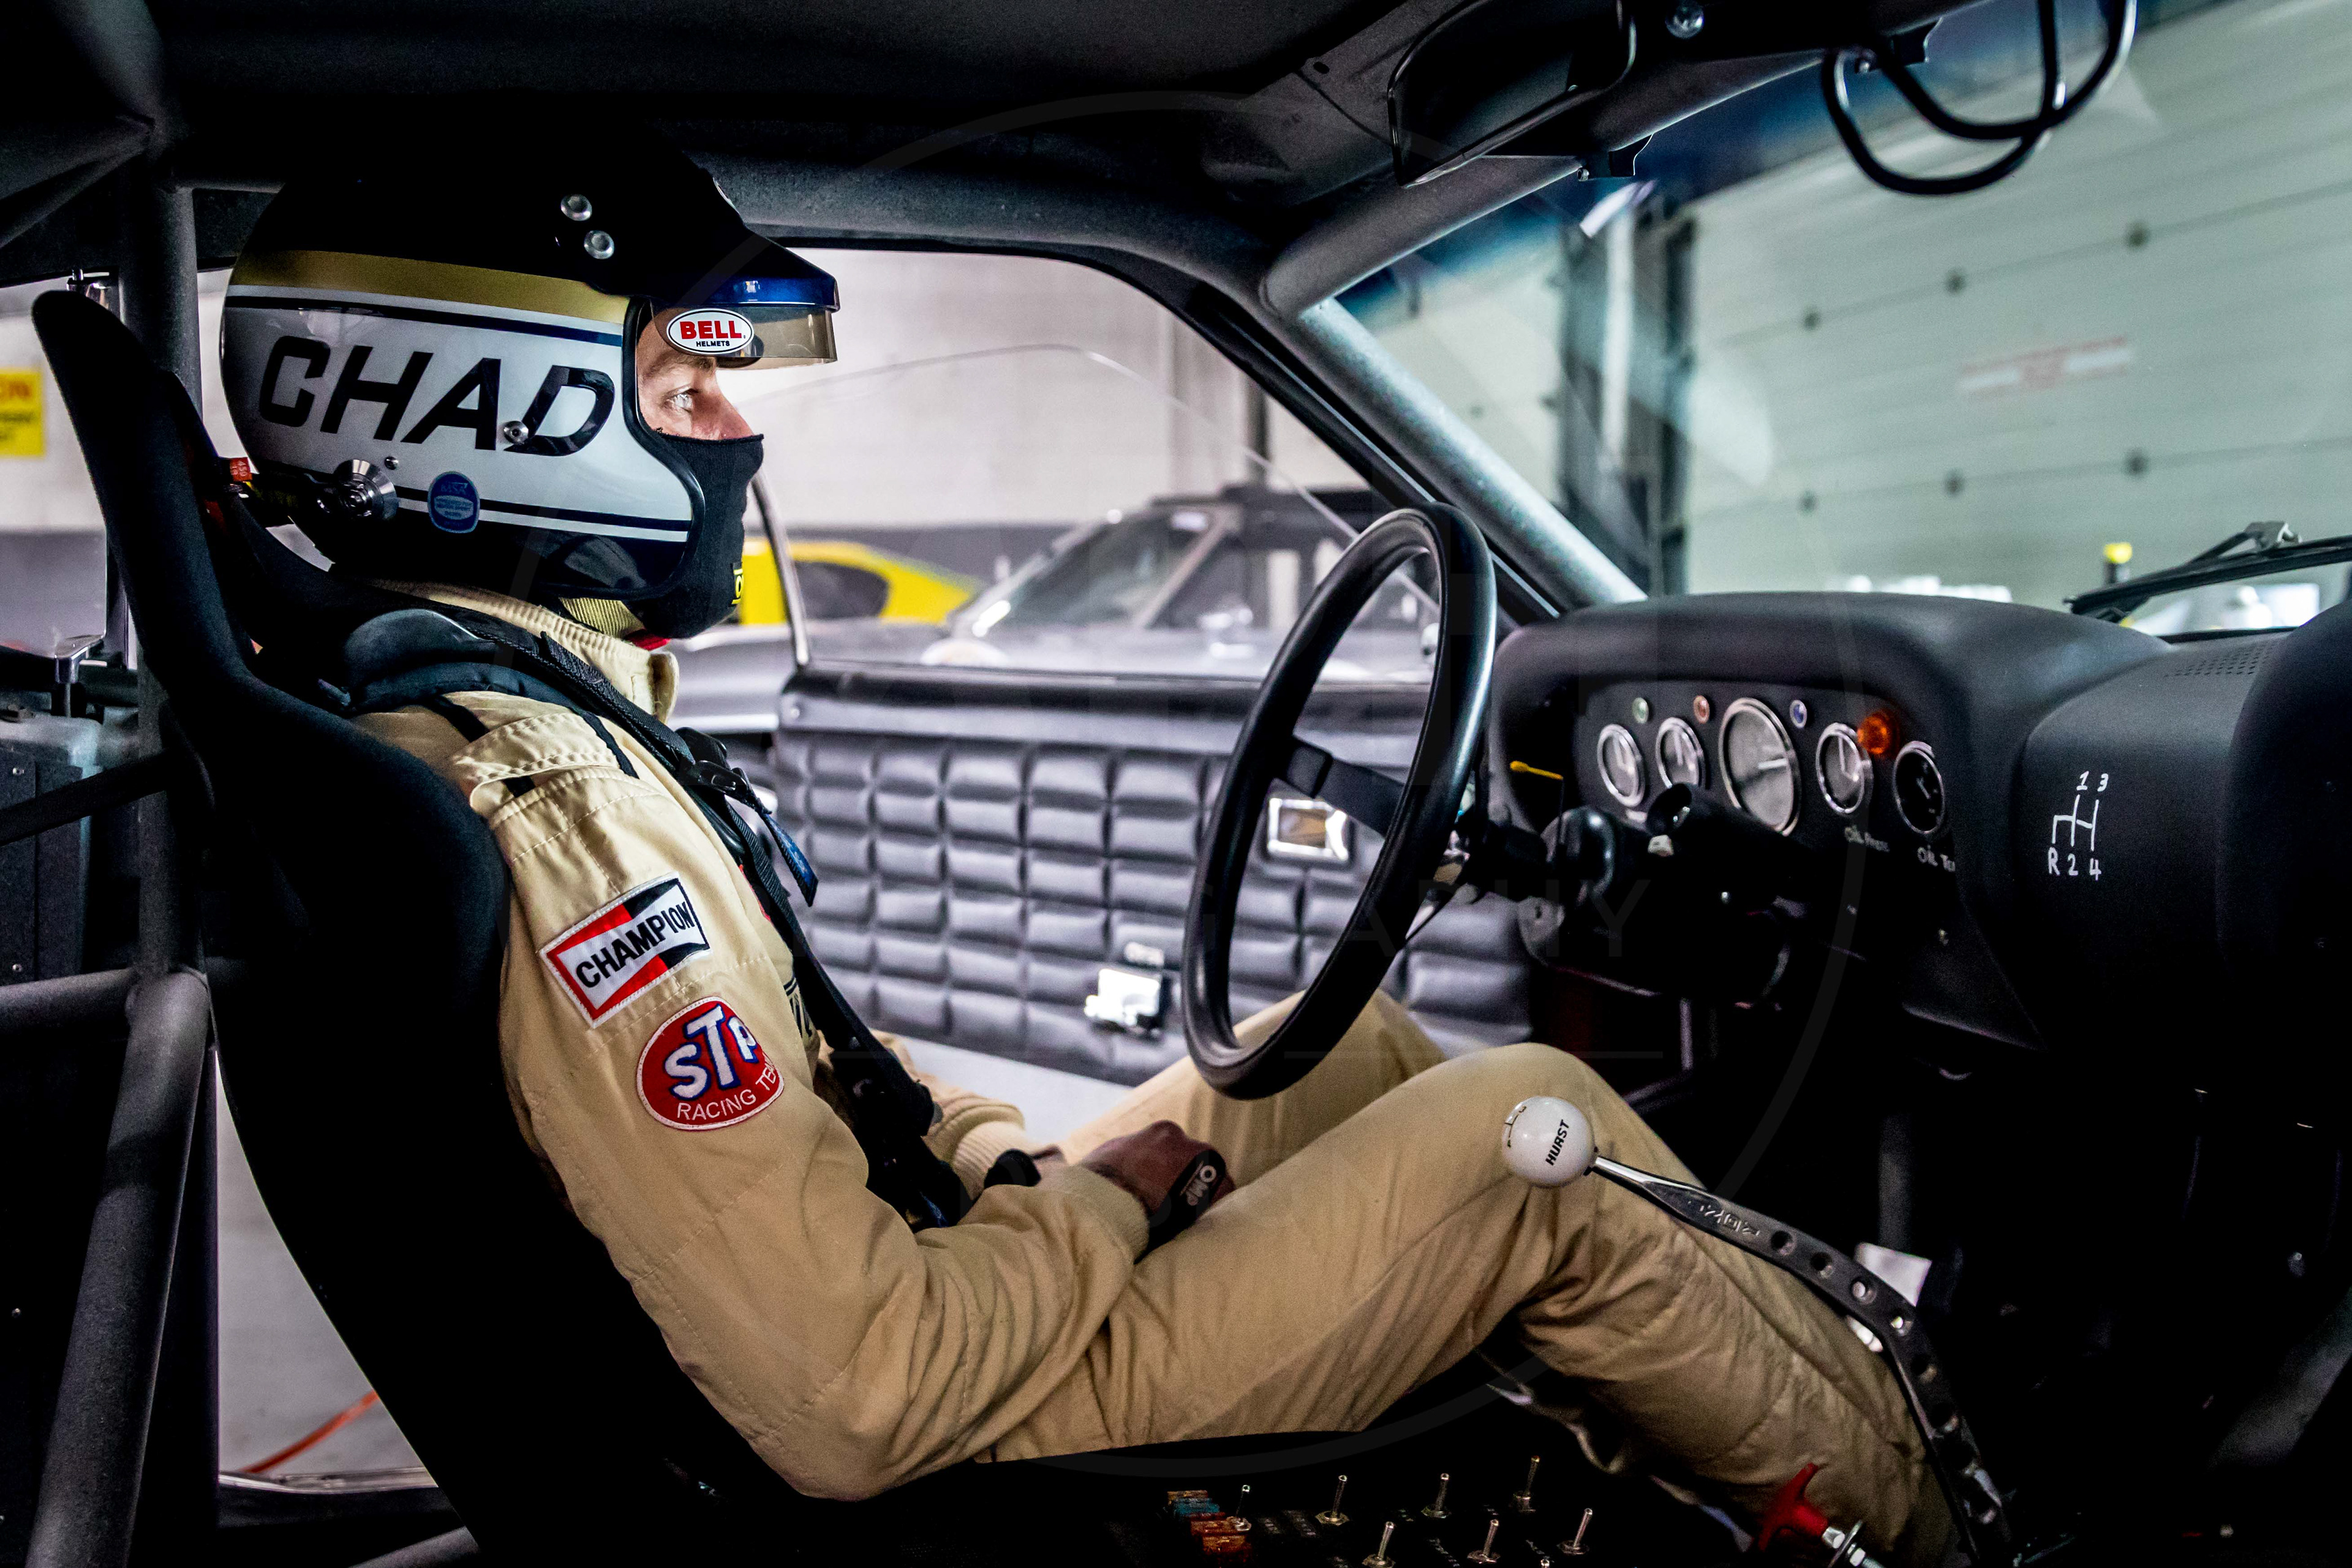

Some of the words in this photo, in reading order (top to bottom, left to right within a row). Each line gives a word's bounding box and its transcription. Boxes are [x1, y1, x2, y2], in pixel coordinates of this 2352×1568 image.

[680, 320, 742, 339] BELL
[259, 336, 615, 456] CHAD
[2076, 771, 2088, 791] 1
[2097, 772, 2109, 792] 3
[2048, 846, 2060, 875] R
[2067, 853, 2079, 877] 2
[2089, 858, 2101, 880] 4
[576, 900, 694, 988] CHAMPION
[664, 1005, 760, 1101] STP
[676, 1088, 757, 1121] RACING
[1545, 1119, 1569, 1166] HURST
